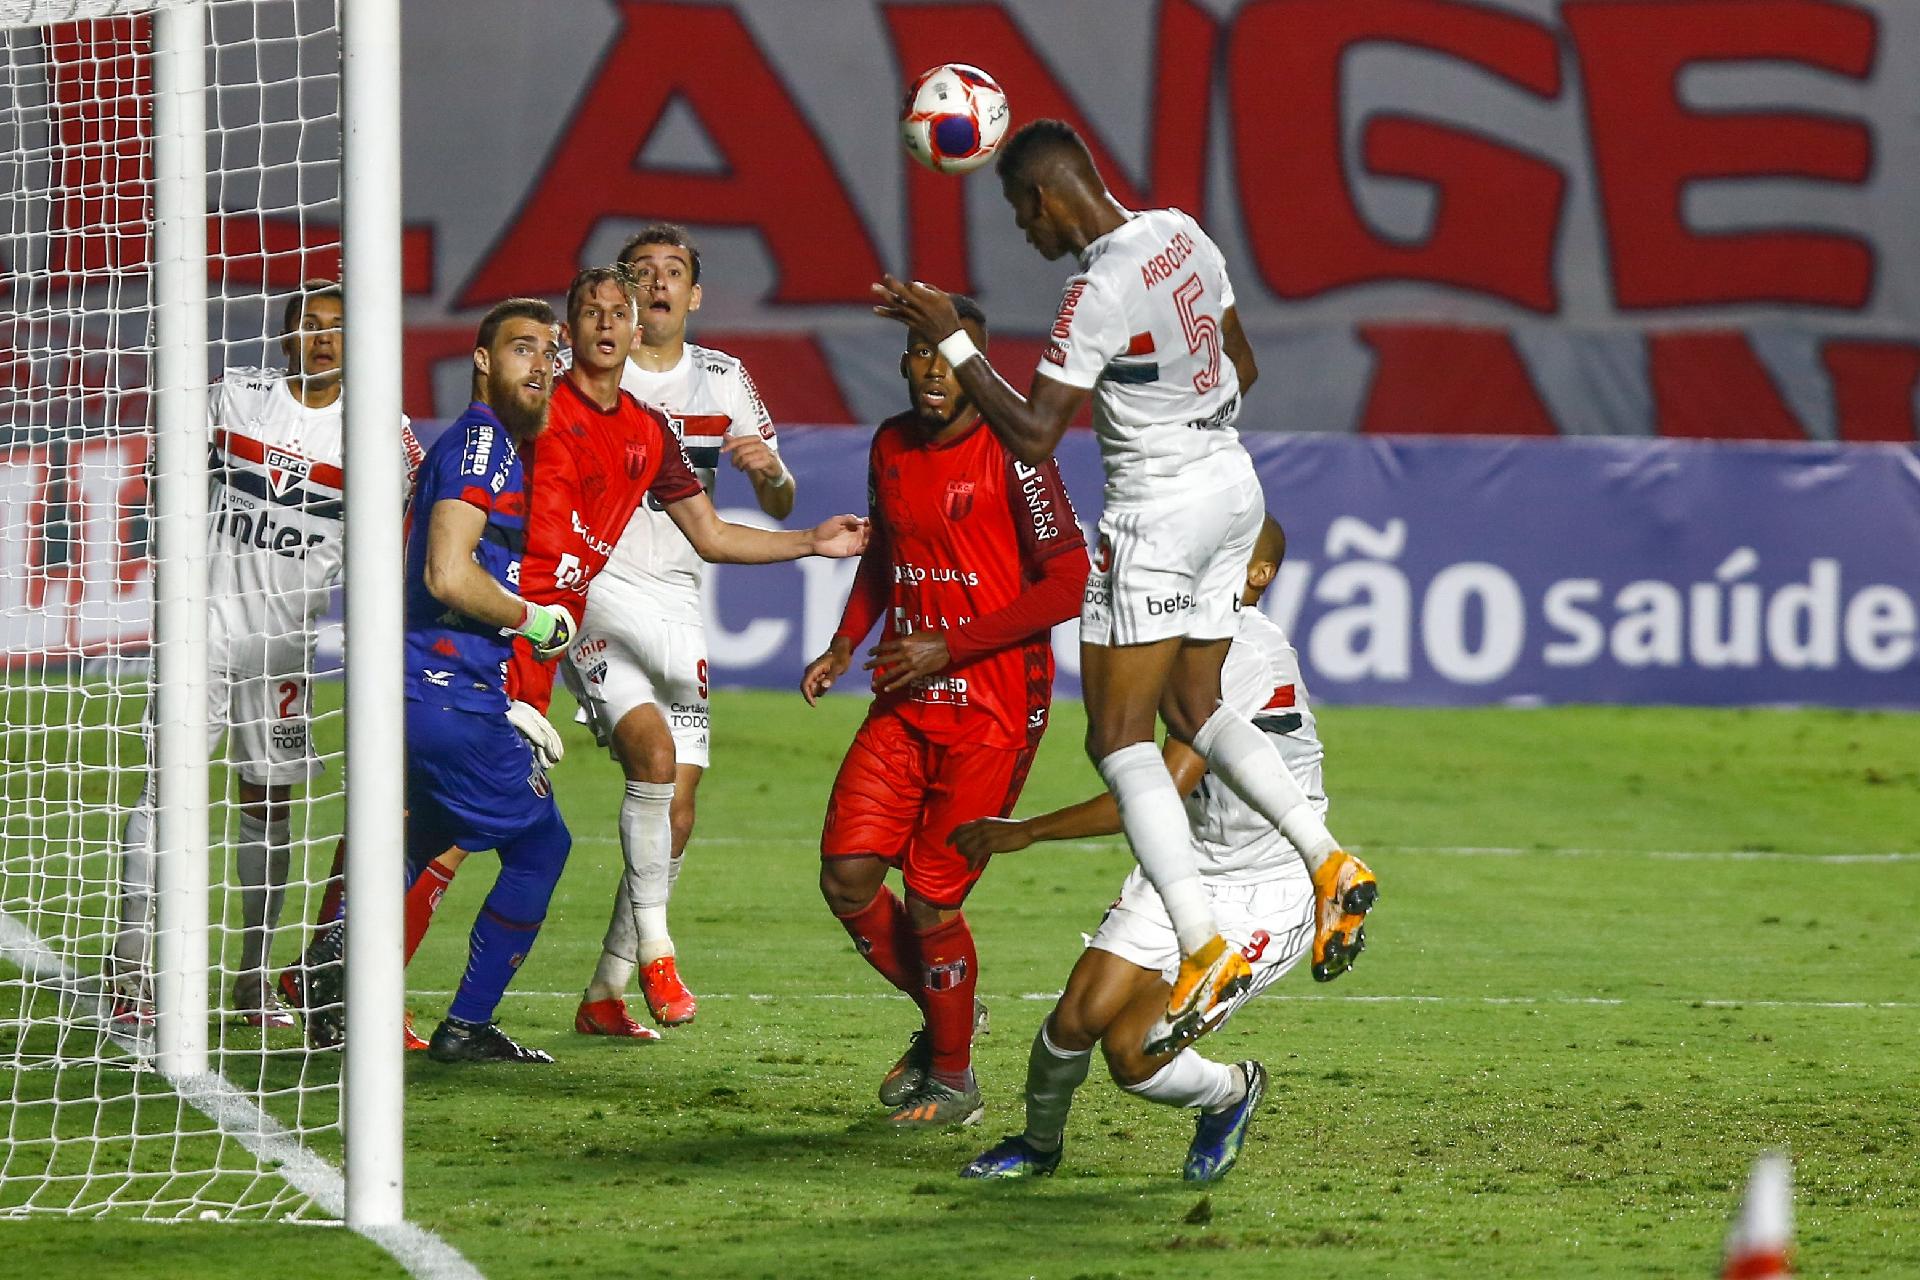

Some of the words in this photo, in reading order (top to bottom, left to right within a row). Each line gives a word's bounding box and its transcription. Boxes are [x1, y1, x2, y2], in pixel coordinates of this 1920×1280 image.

[1172, 271, 1222, 396] 5
[269, 453, 309, 475] SPFC
[1023, 479, 1050, 541] UNION
[216, 503, 326, 560] inter
[1542, 546, 1918, 673] saúde
[575, 637, 608, 664] chip
[279, 680, 299, 719] 2
[697, 658, 708, 700] 9
[1241, 929, 1271, 964] 3
